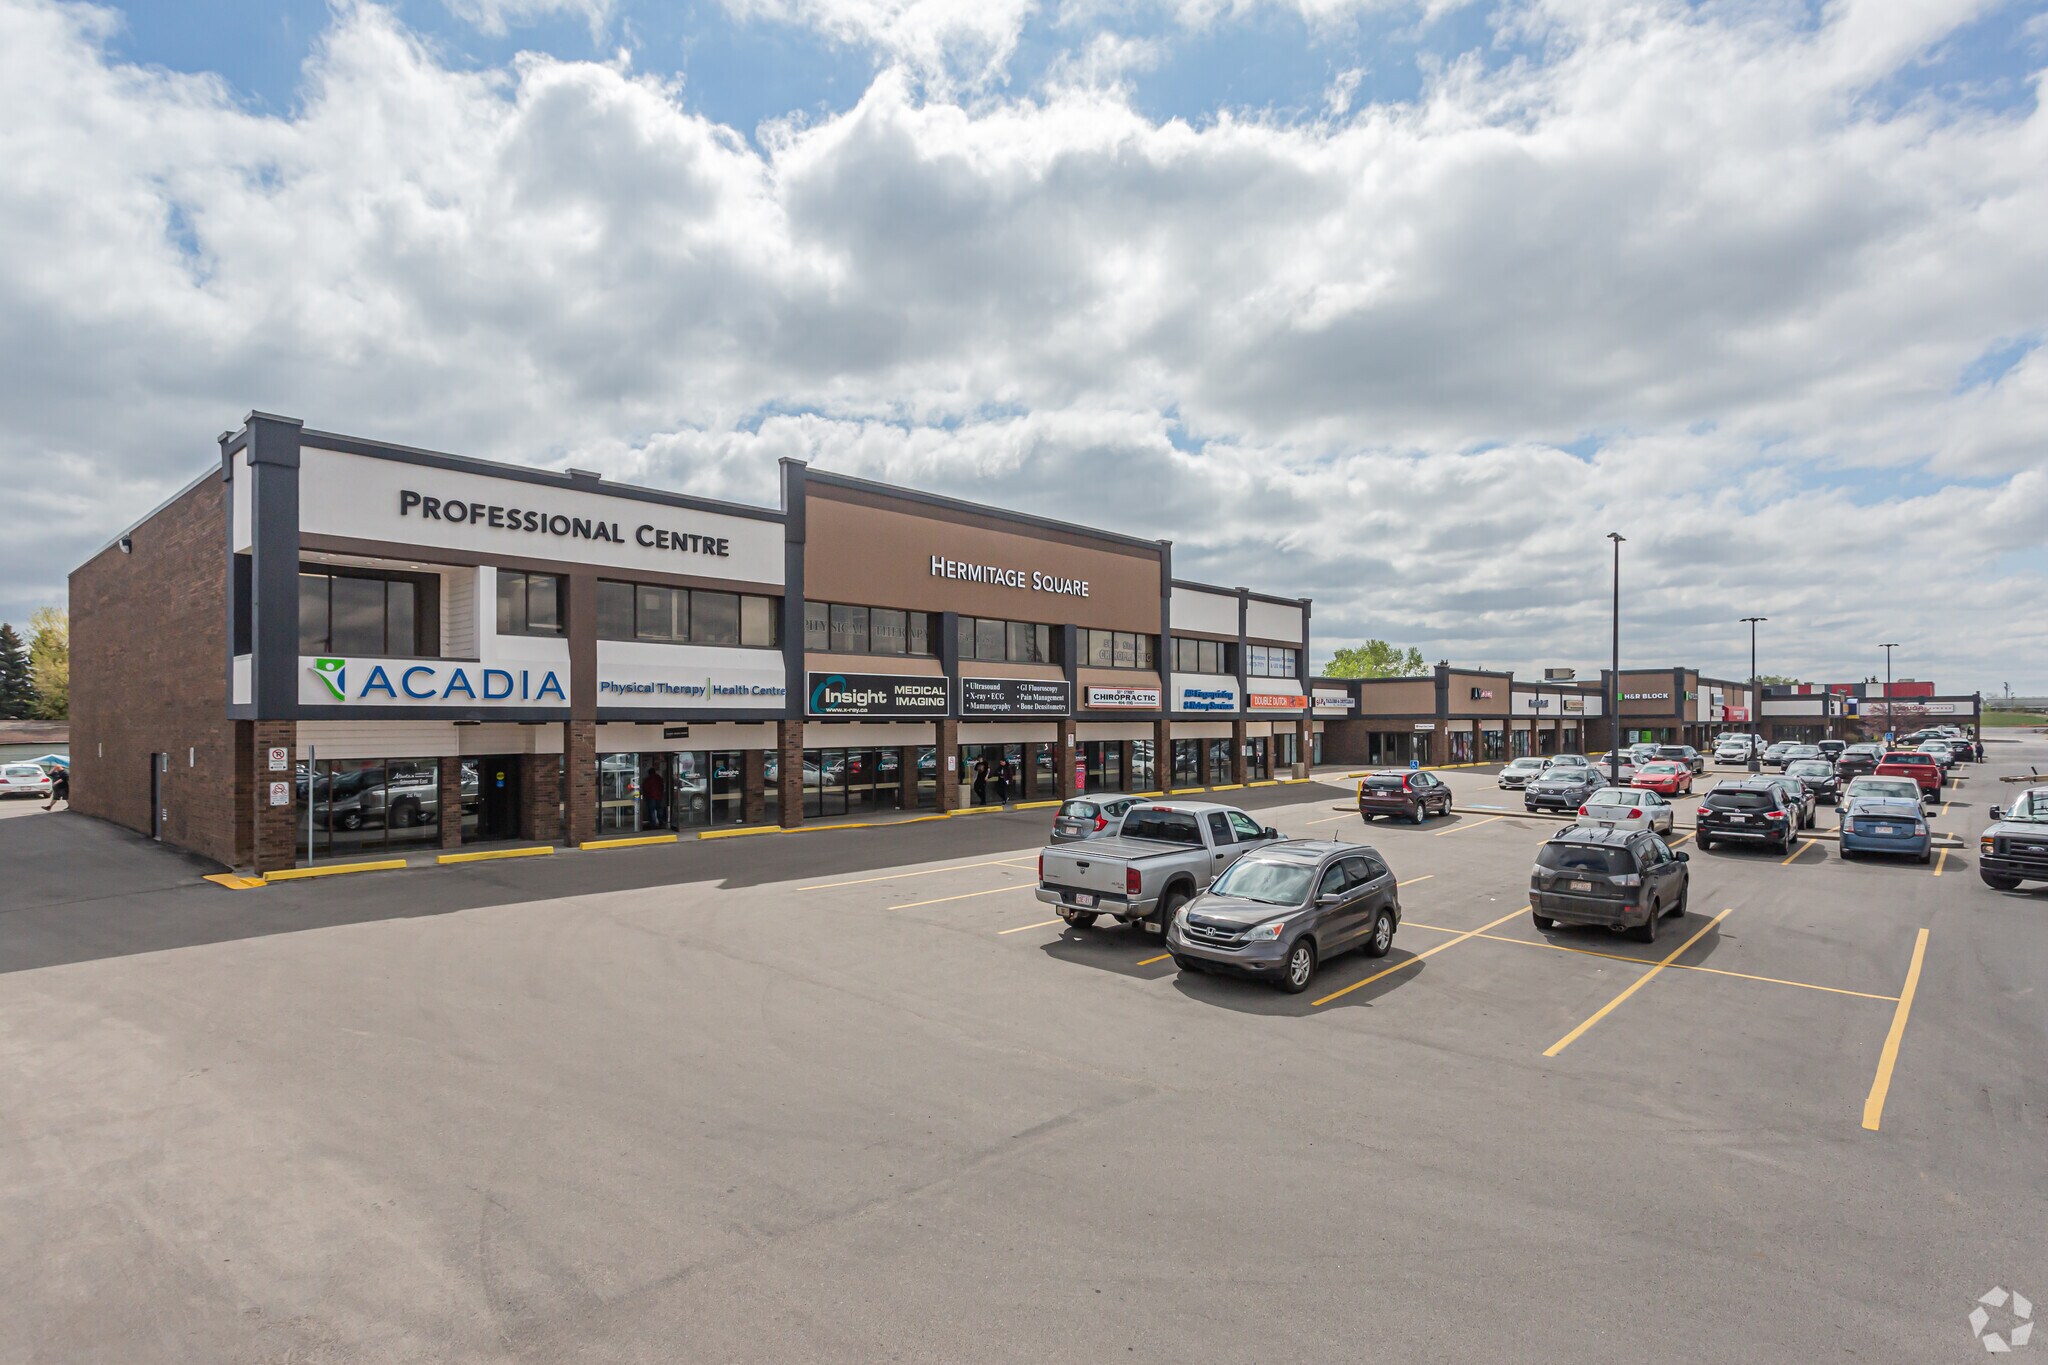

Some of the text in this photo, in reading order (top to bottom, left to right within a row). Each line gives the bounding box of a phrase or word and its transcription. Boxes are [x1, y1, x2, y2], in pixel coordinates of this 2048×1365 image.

[399, 489, 730, 557] PROFESSIONAL CENTRE
[931, 555, 1089, 597] HERMITAGE SQUARE
[358, 665, 566, 700] ACADIA
[970, 683, 1001, 691] Ultrasound
[600, 681, 706, 697] Physical Therapy
[713, 684, 787, 696] Health Centre
[894, 685, 946, 695] MEDICAL
[1028, 685, 1058, 693] Fluoroscopy
[825, 687, 887, 706] Insight
[895, 697, 945, 706] IMAGING
[970, 692, 986, 701] X-ray
[1020, 693, 1064, 702] Pain Management
[1093, 693, 1156, 701] CHIROPRACTIC
[1254, 695, 1272, 705] DOUBLE
[1273, 696, 1287, 706] DUTCH
[970, 702, 1011, 712] Mammography
[1034, 703, 1066, 712] Densitometry
